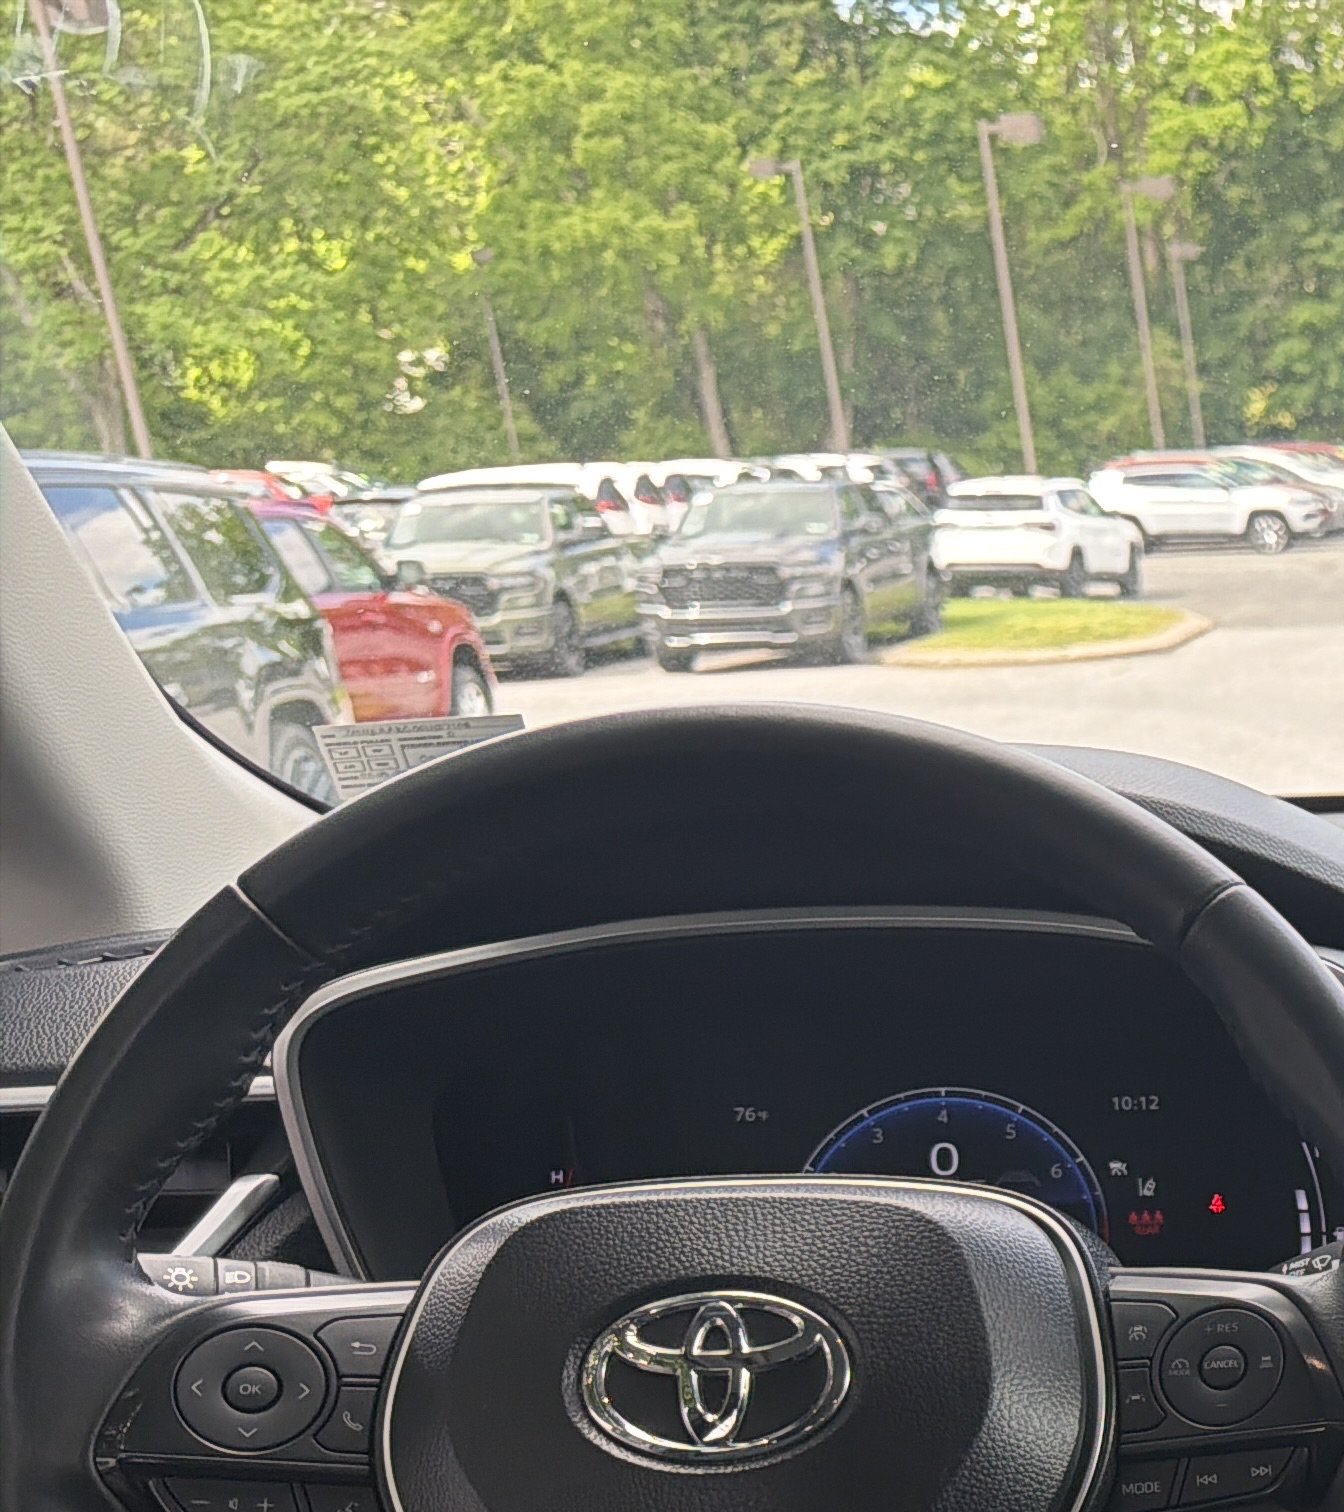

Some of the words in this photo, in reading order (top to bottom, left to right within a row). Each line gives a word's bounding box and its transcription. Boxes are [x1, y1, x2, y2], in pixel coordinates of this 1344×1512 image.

[1112, 1095, 1160, 1111] 10:12
[937, 1110, 949, 1124] 4
[872, 1128, 885, 1144] 3
[1005, 1123, 1017, 1139] 5
[930, 1142, 959, 1177] 0
[550, 1169, 564, 1184] H
[1050, 1163, 1063, 1178] 6
[1216, 1322, 1239, 1334] RES
[1204, 1359, 1239, 1370] CANCEL
[239, 1383, 262, 1394] OK
[1121, 1481, 1162, 1496] MODE
